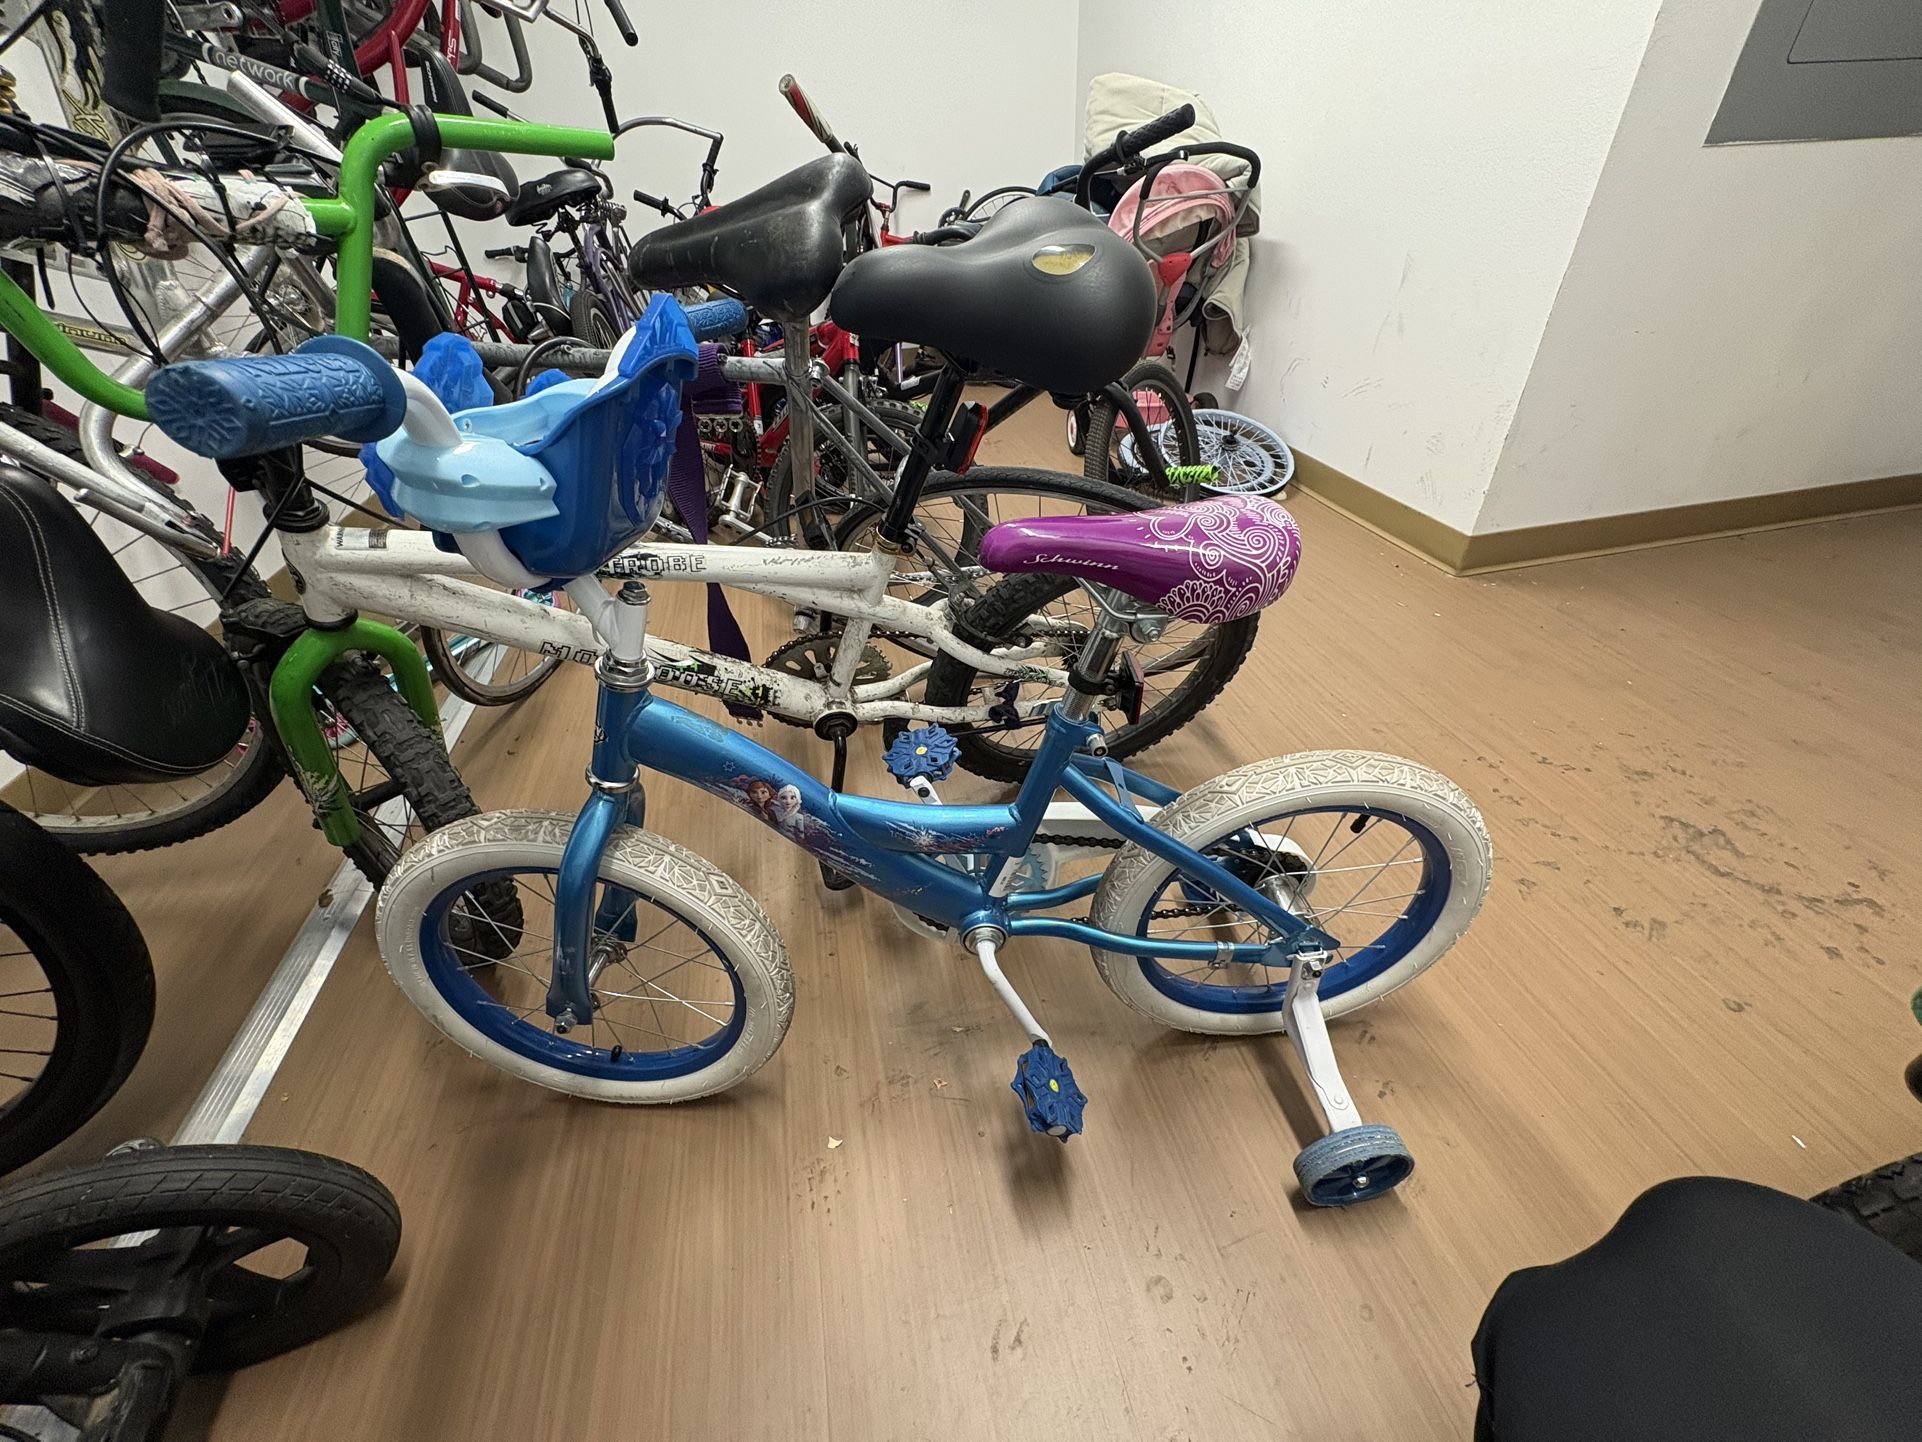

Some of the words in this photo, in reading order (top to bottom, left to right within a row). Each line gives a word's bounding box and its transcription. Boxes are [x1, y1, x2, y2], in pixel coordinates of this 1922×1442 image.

[215, 50, 297, 91] network
[603, 553, 707, 576] TROBE
[1022, 553, 1120, 571] Schwinn
